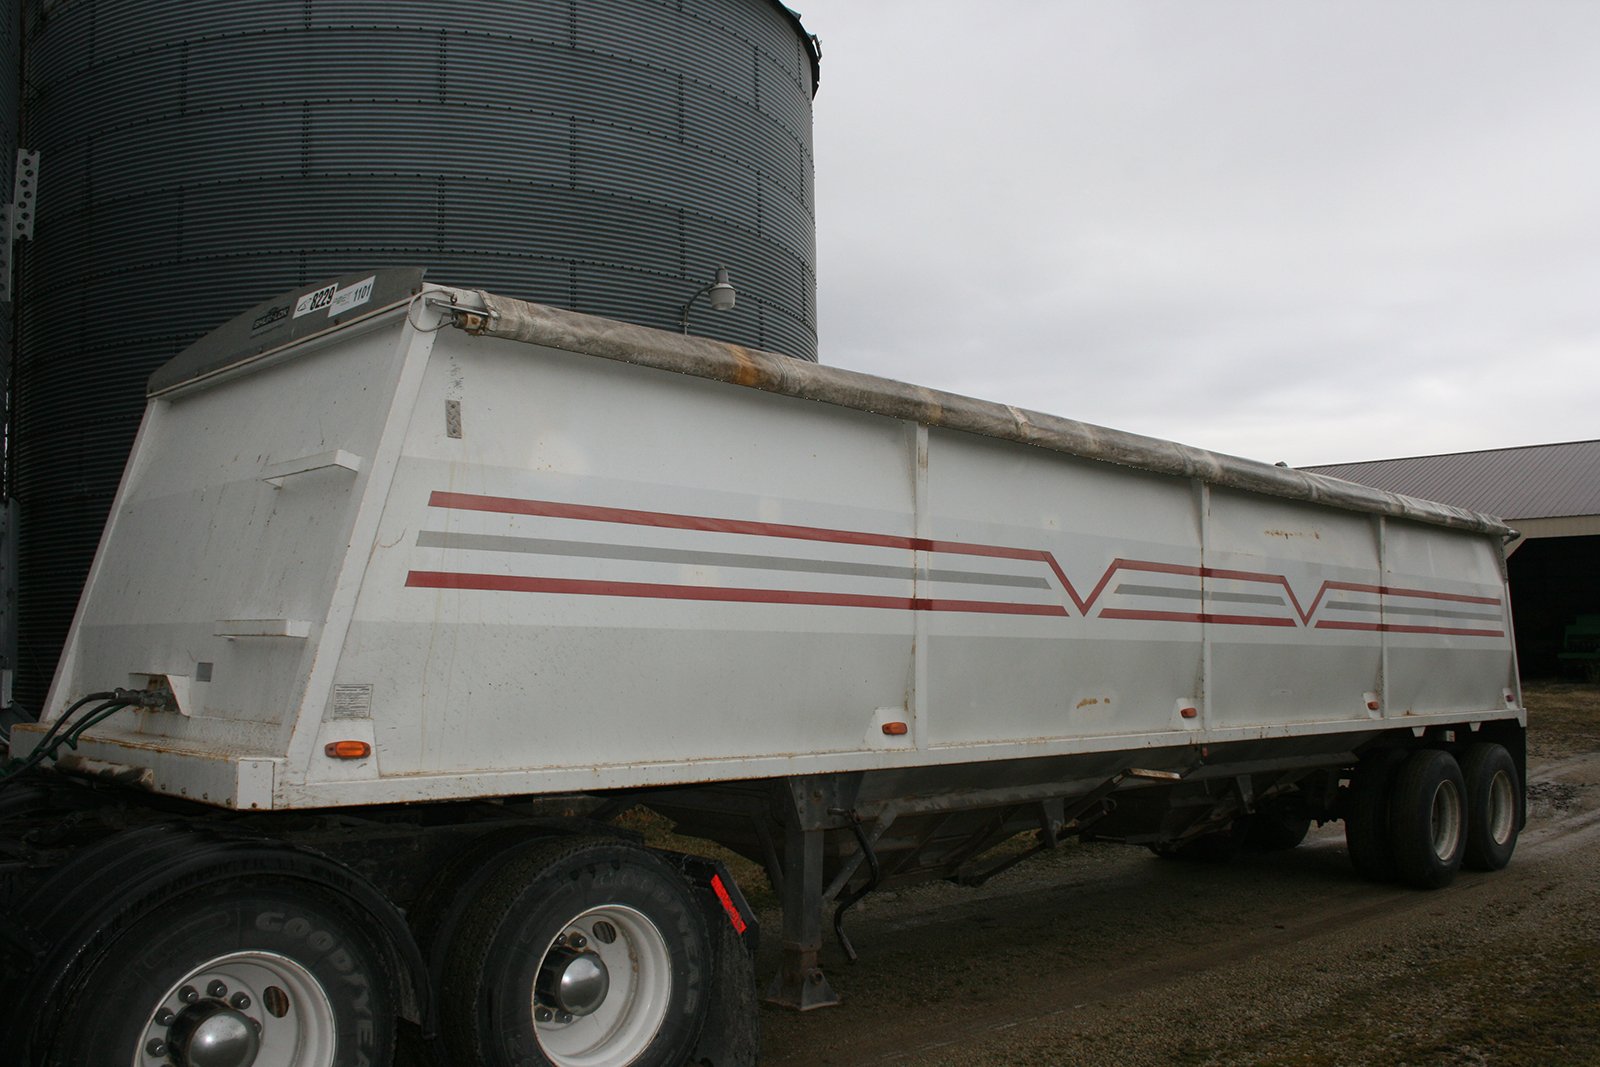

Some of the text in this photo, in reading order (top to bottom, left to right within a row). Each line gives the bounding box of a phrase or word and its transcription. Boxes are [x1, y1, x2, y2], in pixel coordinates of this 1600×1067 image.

[310, 286, 335, 310] 8229
[353, 283, 372, 302] 1101
[255, 911, 374, 1067] GOODYEA
